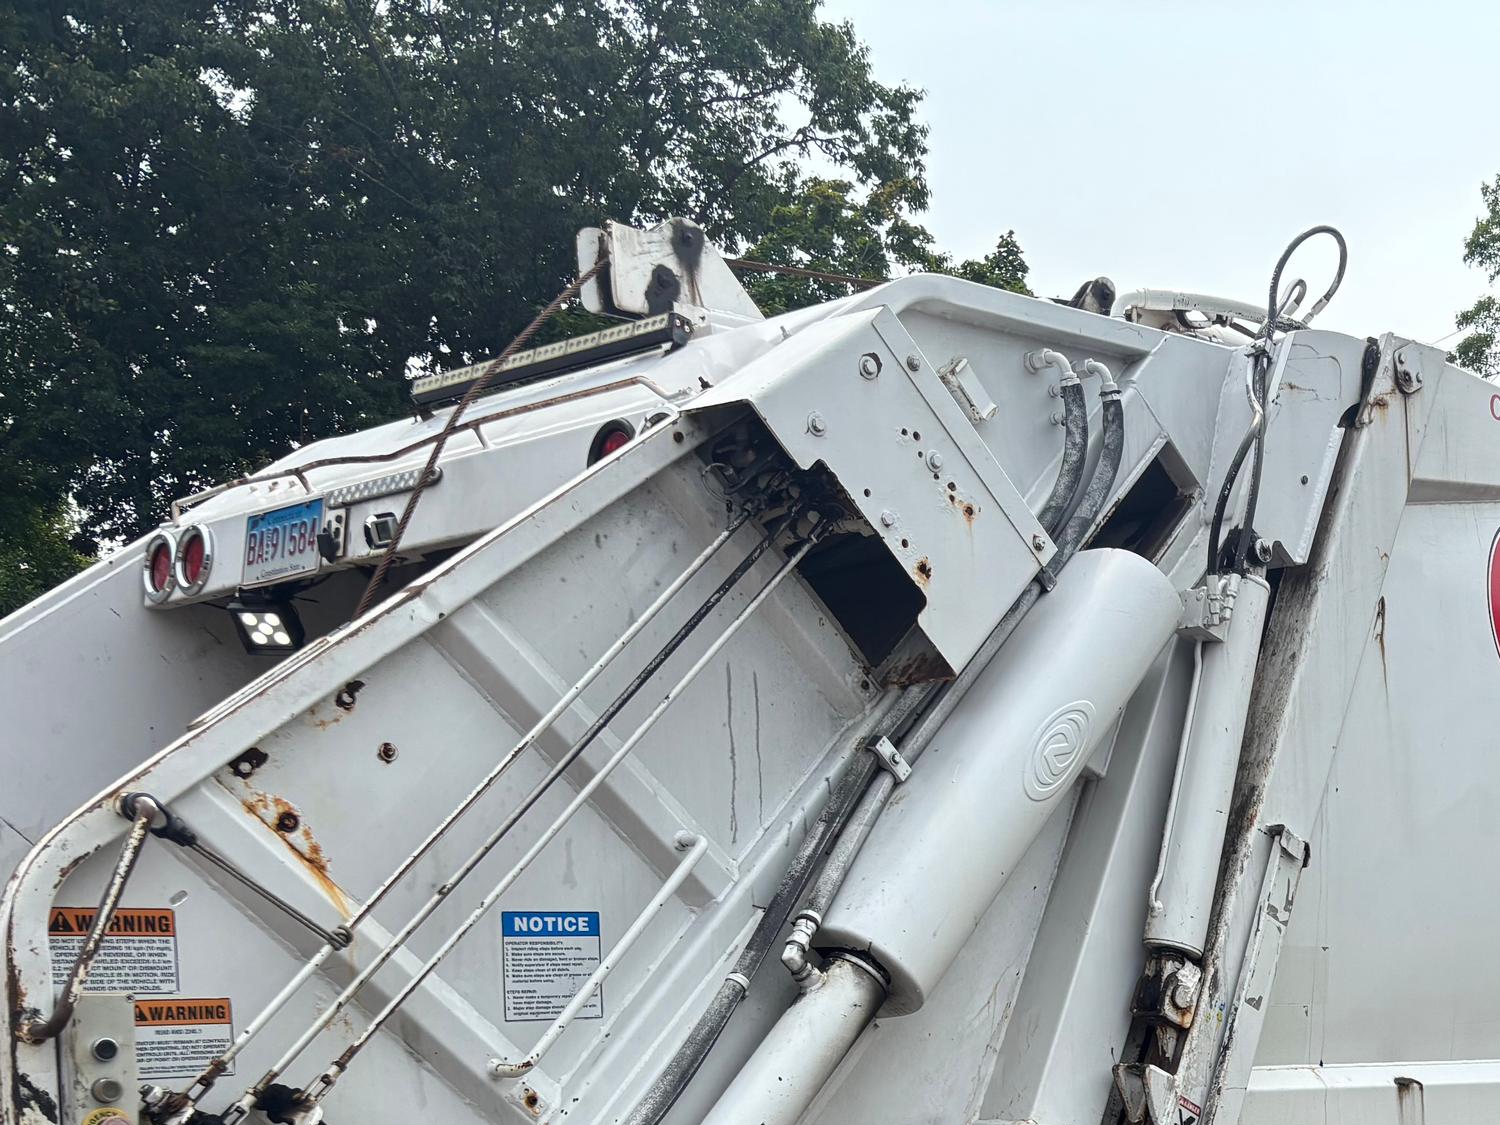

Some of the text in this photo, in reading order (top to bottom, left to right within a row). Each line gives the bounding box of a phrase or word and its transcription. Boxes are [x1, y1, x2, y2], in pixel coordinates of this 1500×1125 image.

[75, 915, 170, 932] WRNING
[514, 917, 589, 931] NOTICE
[148, 1005, 225, 1020] WARNING
